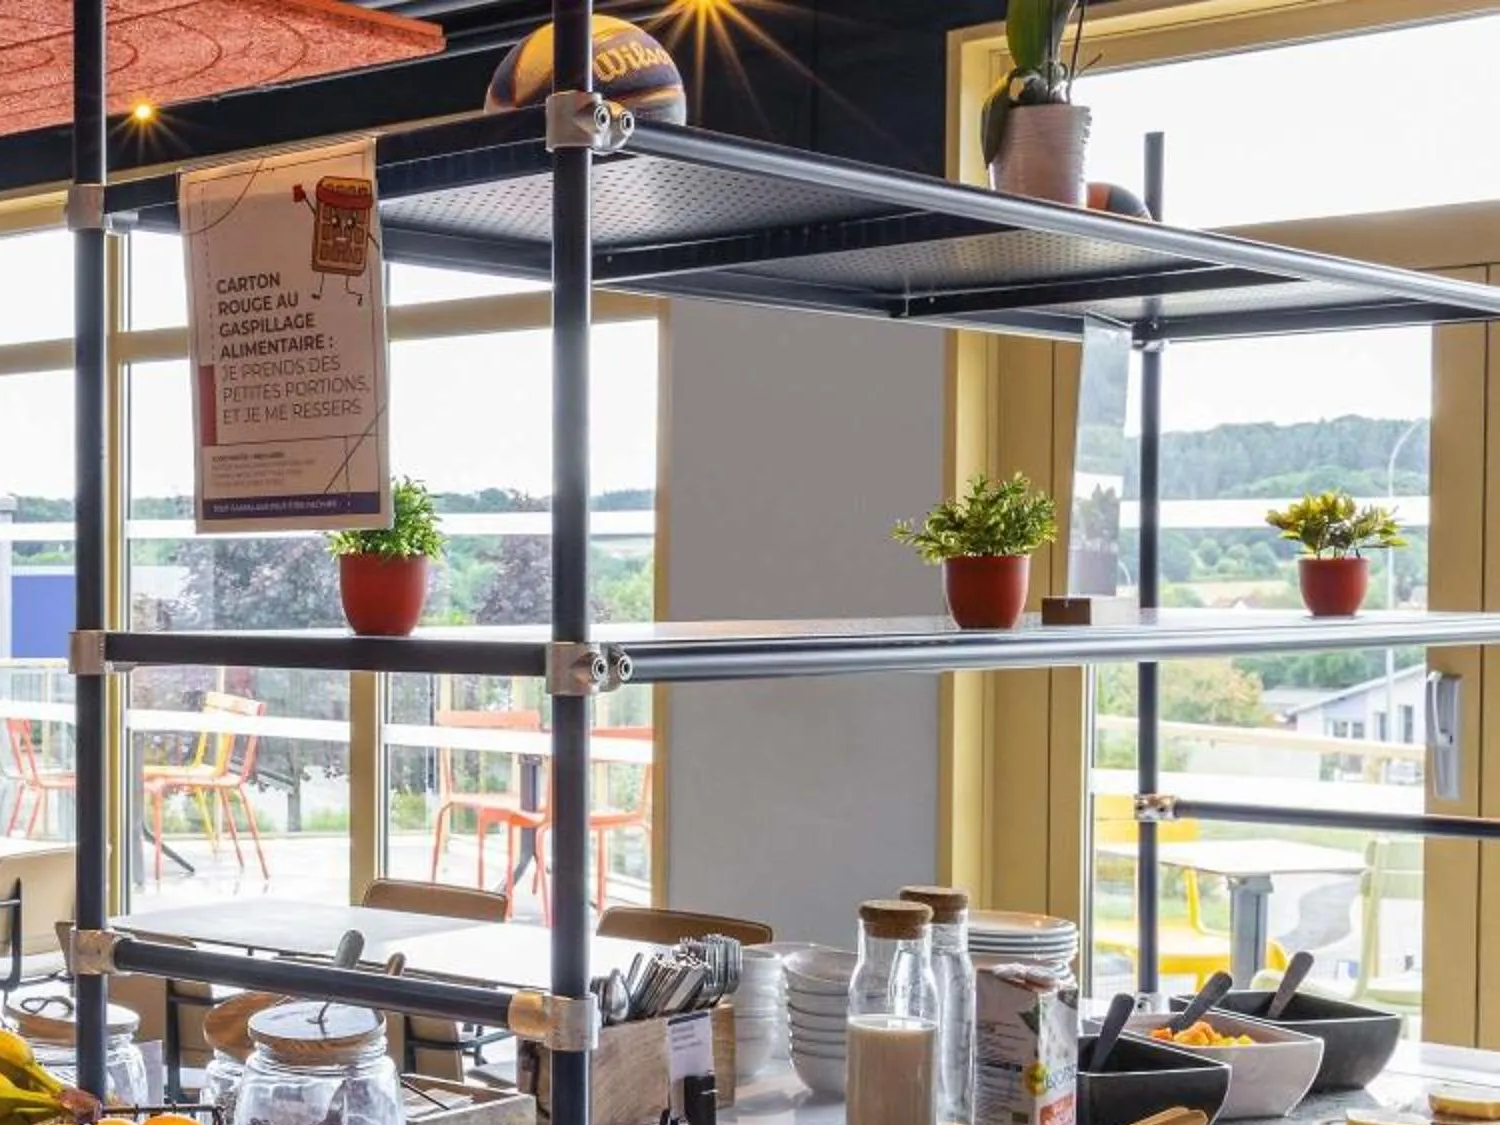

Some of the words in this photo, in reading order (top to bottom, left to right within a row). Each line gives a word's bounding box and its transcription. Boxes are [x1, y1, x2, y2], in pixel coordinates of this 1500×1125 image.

[593, 41, 673, 82] Wilso
[216, 272, 281, 294] CARTON
[218, 295, 273, 316] ROUGE
[277, 292, 299, 309] AU
[219, 312, 316, 338] GASPILLAGE
[220, 334, 325, 360] ALIMENTAIRE
[222, 365, 237, 382] JE
[242, 357, 305, 379] PRENDS
[309, 355, 341, 373] DES
[223, 383, 281, 403] PETITES
[223, 408, 240, 425] ET
[243, 406, 261, 423] JE
[265, 404, 288, 421] ME
[293, 398, 363, 420] RESSERS
